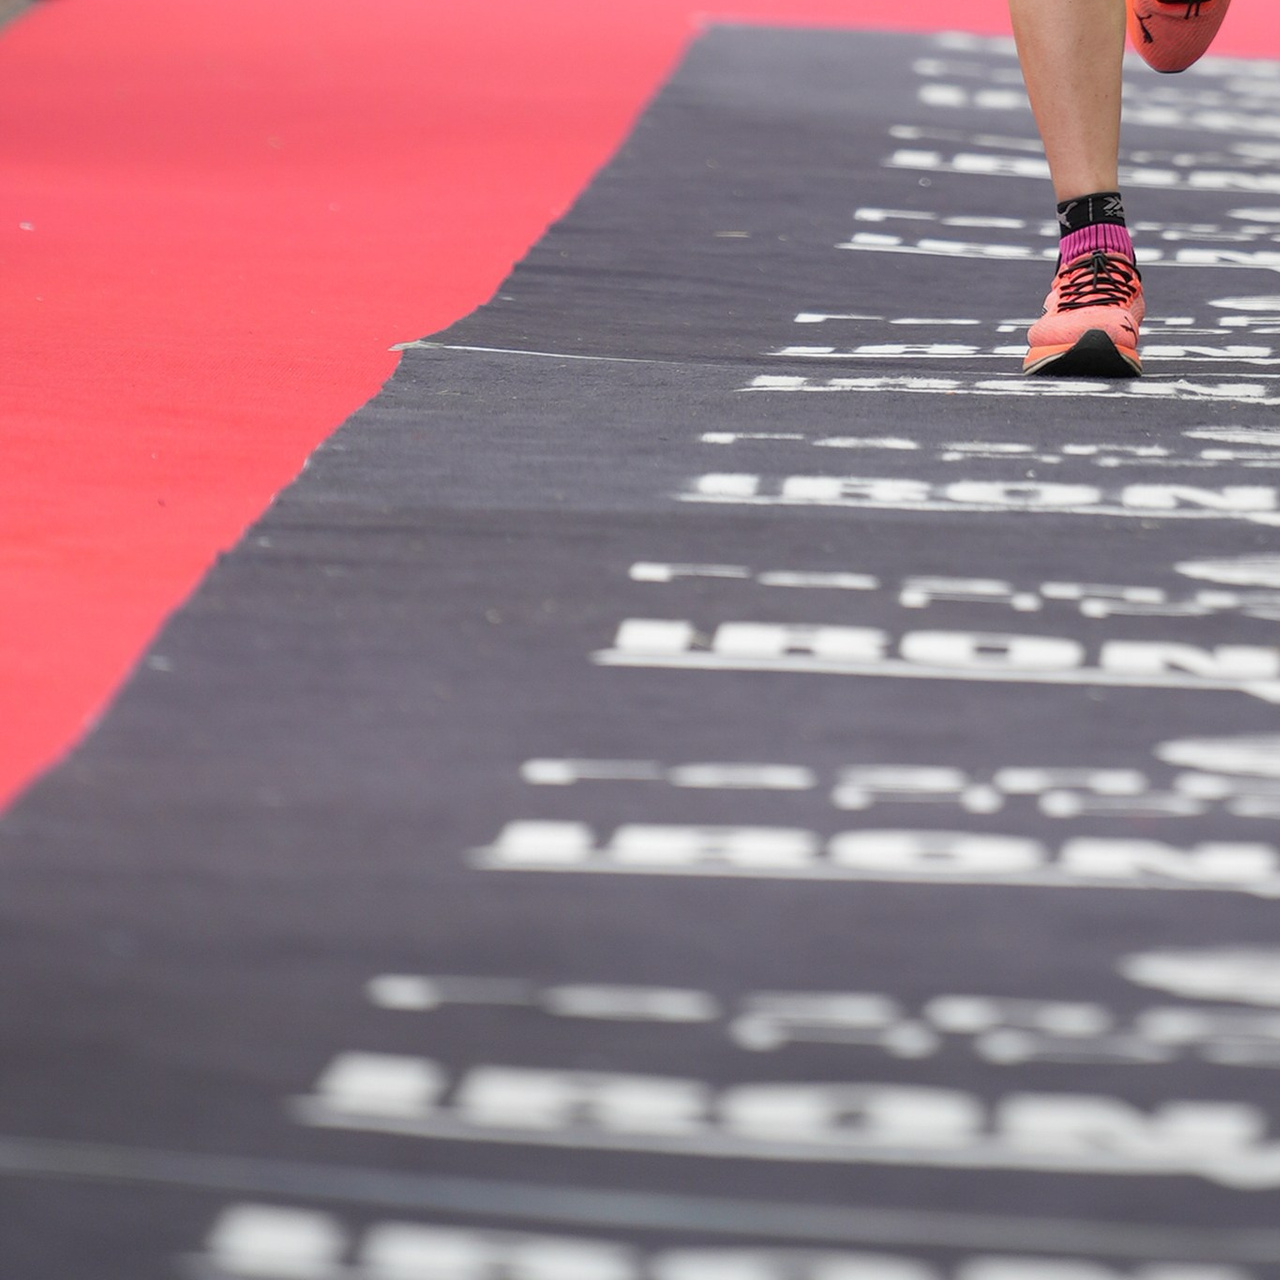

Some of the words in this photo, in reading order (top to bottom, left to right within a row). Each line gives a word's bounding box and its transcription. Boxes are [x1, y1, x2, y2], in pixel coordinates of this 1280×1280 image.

[749, 375, 1267, 397] IRON
[695, 473, 1279, 511] IRON
[313, 1050, 1266, 1159] IRON
